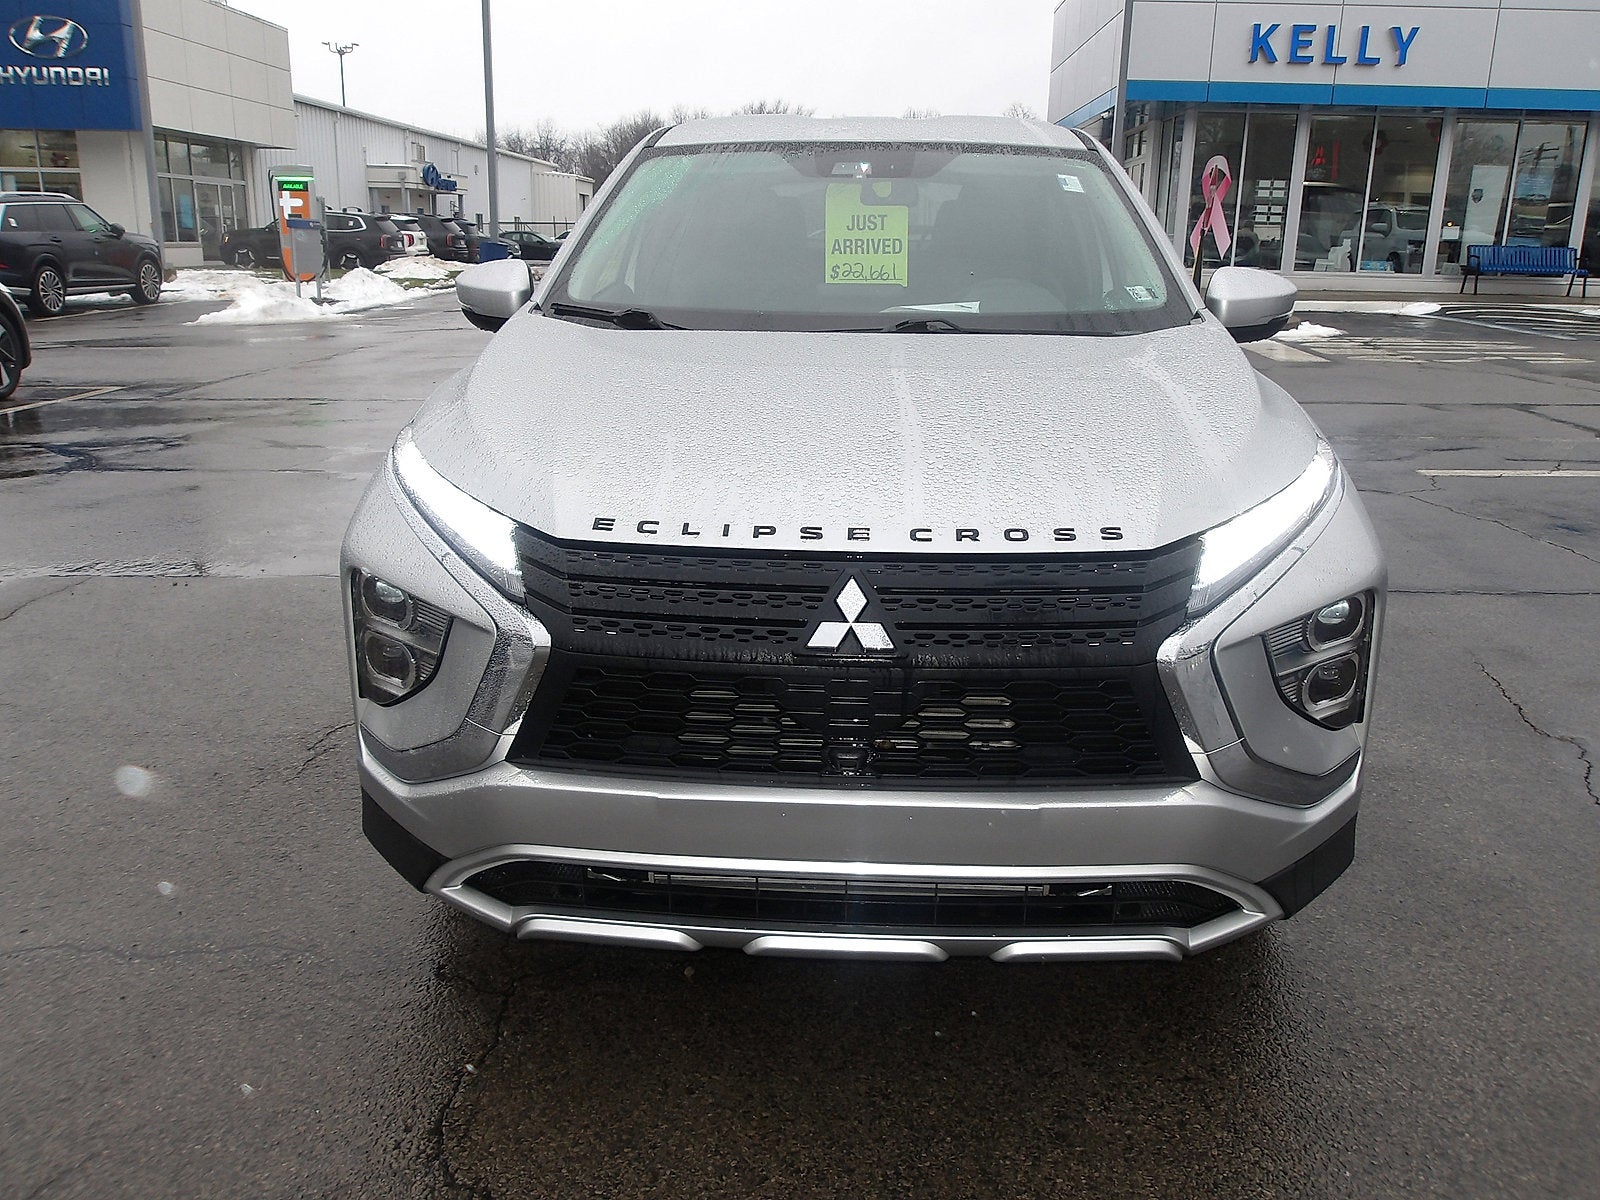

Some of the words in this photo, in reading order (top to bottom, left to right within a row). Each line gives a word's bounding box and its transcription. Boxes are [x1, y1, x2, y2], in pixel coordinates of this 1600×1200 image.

[1248, 22, 1421, 66] KELLY
[0, 66, 110, 86] HYUNDAI
[846, 214, 888, 231] JUST
[831, 238, 903, 255] ARRIVED
[830, 263, 896, 282] $22,661
[592, 517, 871, 541] ECLIPSE
[909, 526, 1124, 542] CROSS
